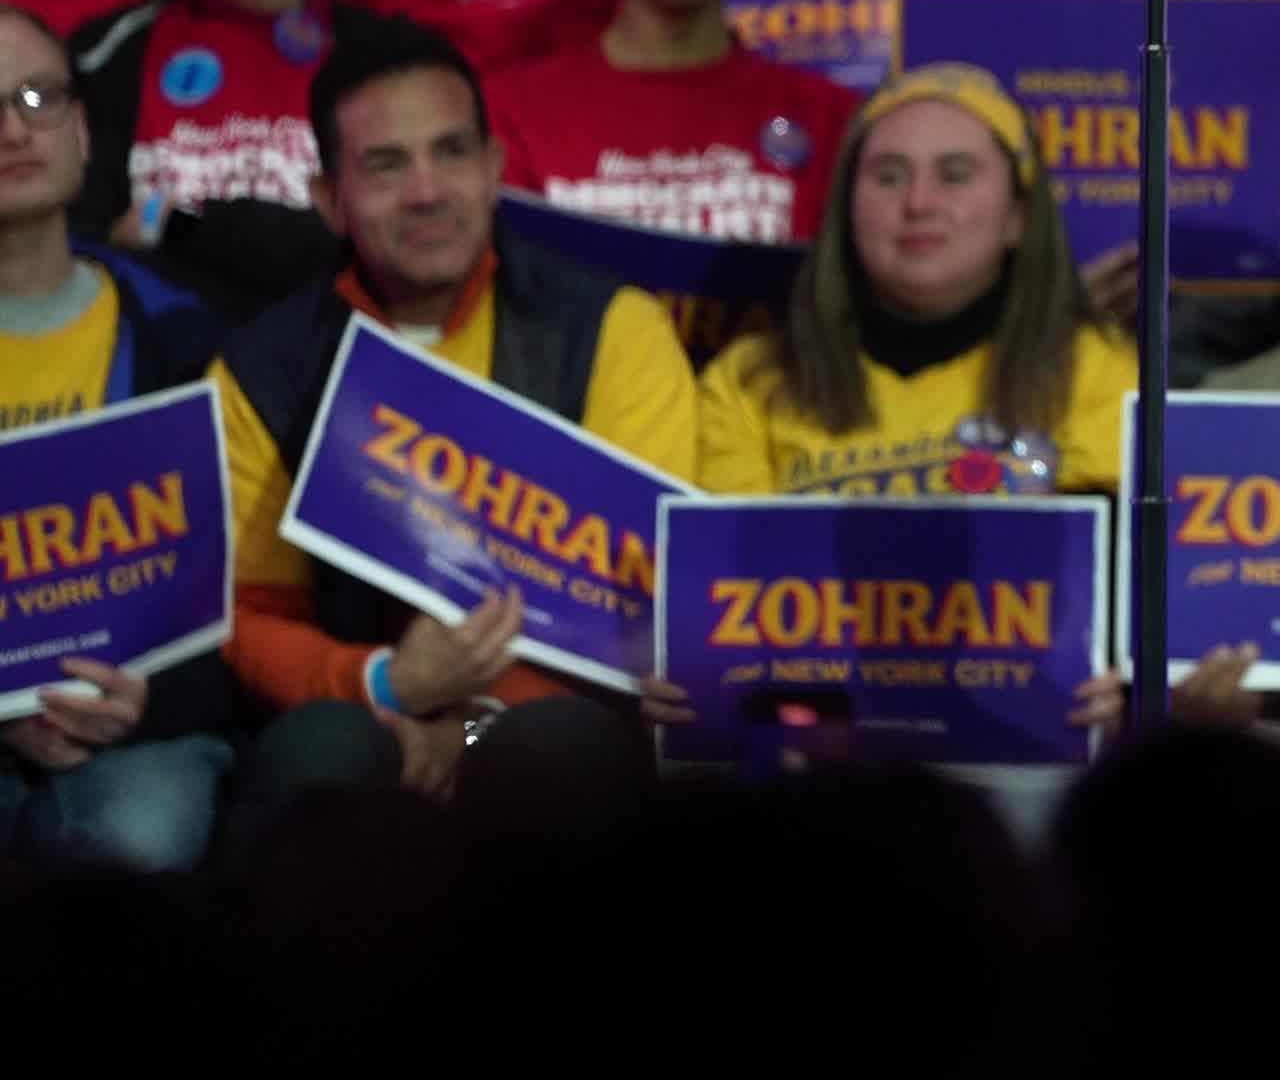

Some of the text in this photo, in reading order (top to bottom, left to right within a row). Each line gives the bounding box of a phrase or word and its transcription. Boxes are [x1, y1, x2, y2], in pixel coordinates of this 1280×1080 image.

[1036, 104, 1250, 172] HRAN
[0, 469, 190, 582] HRAN
[15, 573, 104, 618] YORK
[107, 549, 179, 597] CITY
[707, 577, 1055, 651] ZOHRAN
[770, 658, 851, 685] NEW
[858, 659, 947, 688] YORK
[953, 658, 1035, 689] CITY
